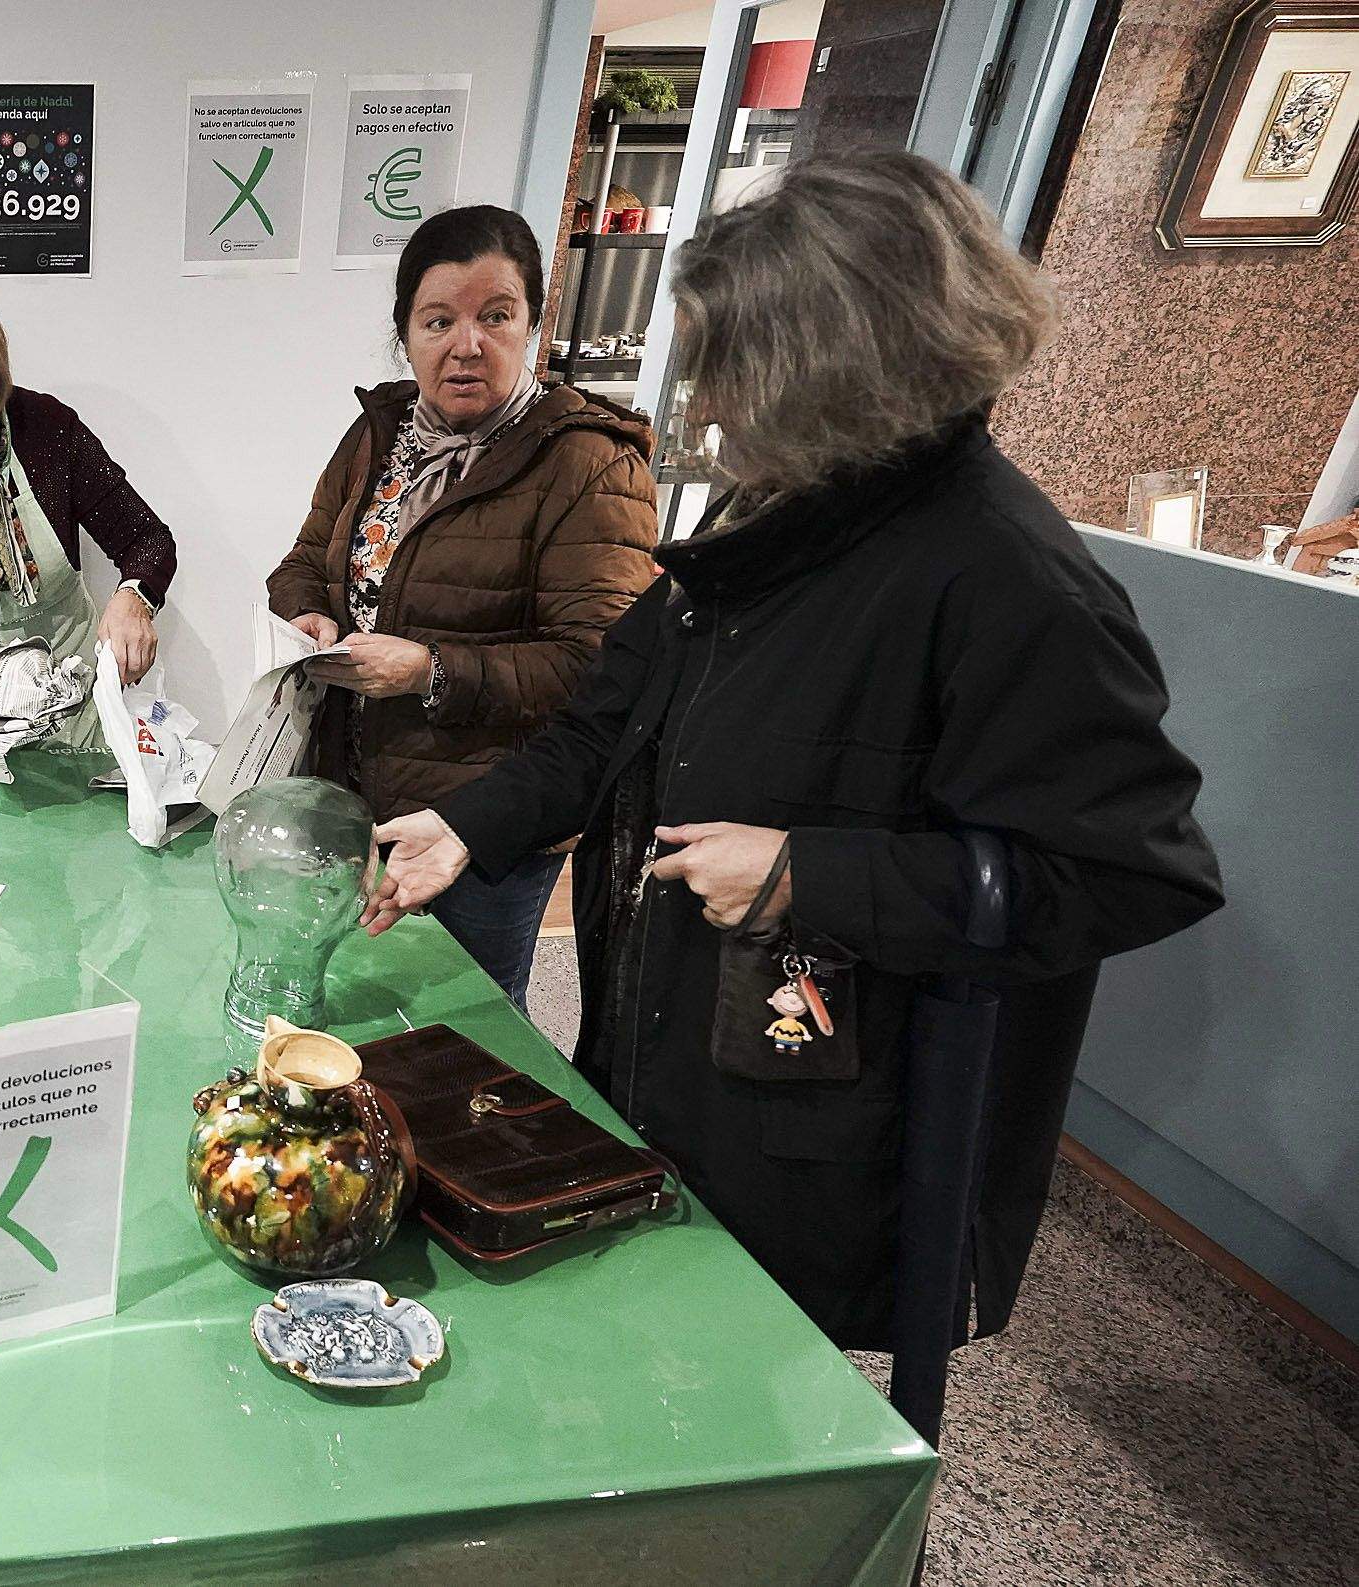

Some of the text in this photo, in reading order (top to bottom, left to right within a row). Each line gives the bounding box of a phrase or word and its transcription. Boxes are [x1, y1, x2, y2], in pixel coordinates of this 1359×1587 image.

[23, 96, 38, 107] de
[40, 96, 74, 107] Nadal
[24, 108, 49, 122] aquí
[194, 106, 303, 117] No se aceptan devoluciones
[362, 103, 451, 117] Solo se aceptan
[200, 120, 221, 128] salvo
[268, 120, 284, 129] que
[355, 121, 454, 136] pagos en efectivo
[198, 131, 296, 141] funcionen correctamente
[0, 1059, 112, 1090] devoluciones
[40, 1088, 73, 1103] que
[76, 1083, 97, 1096] no
